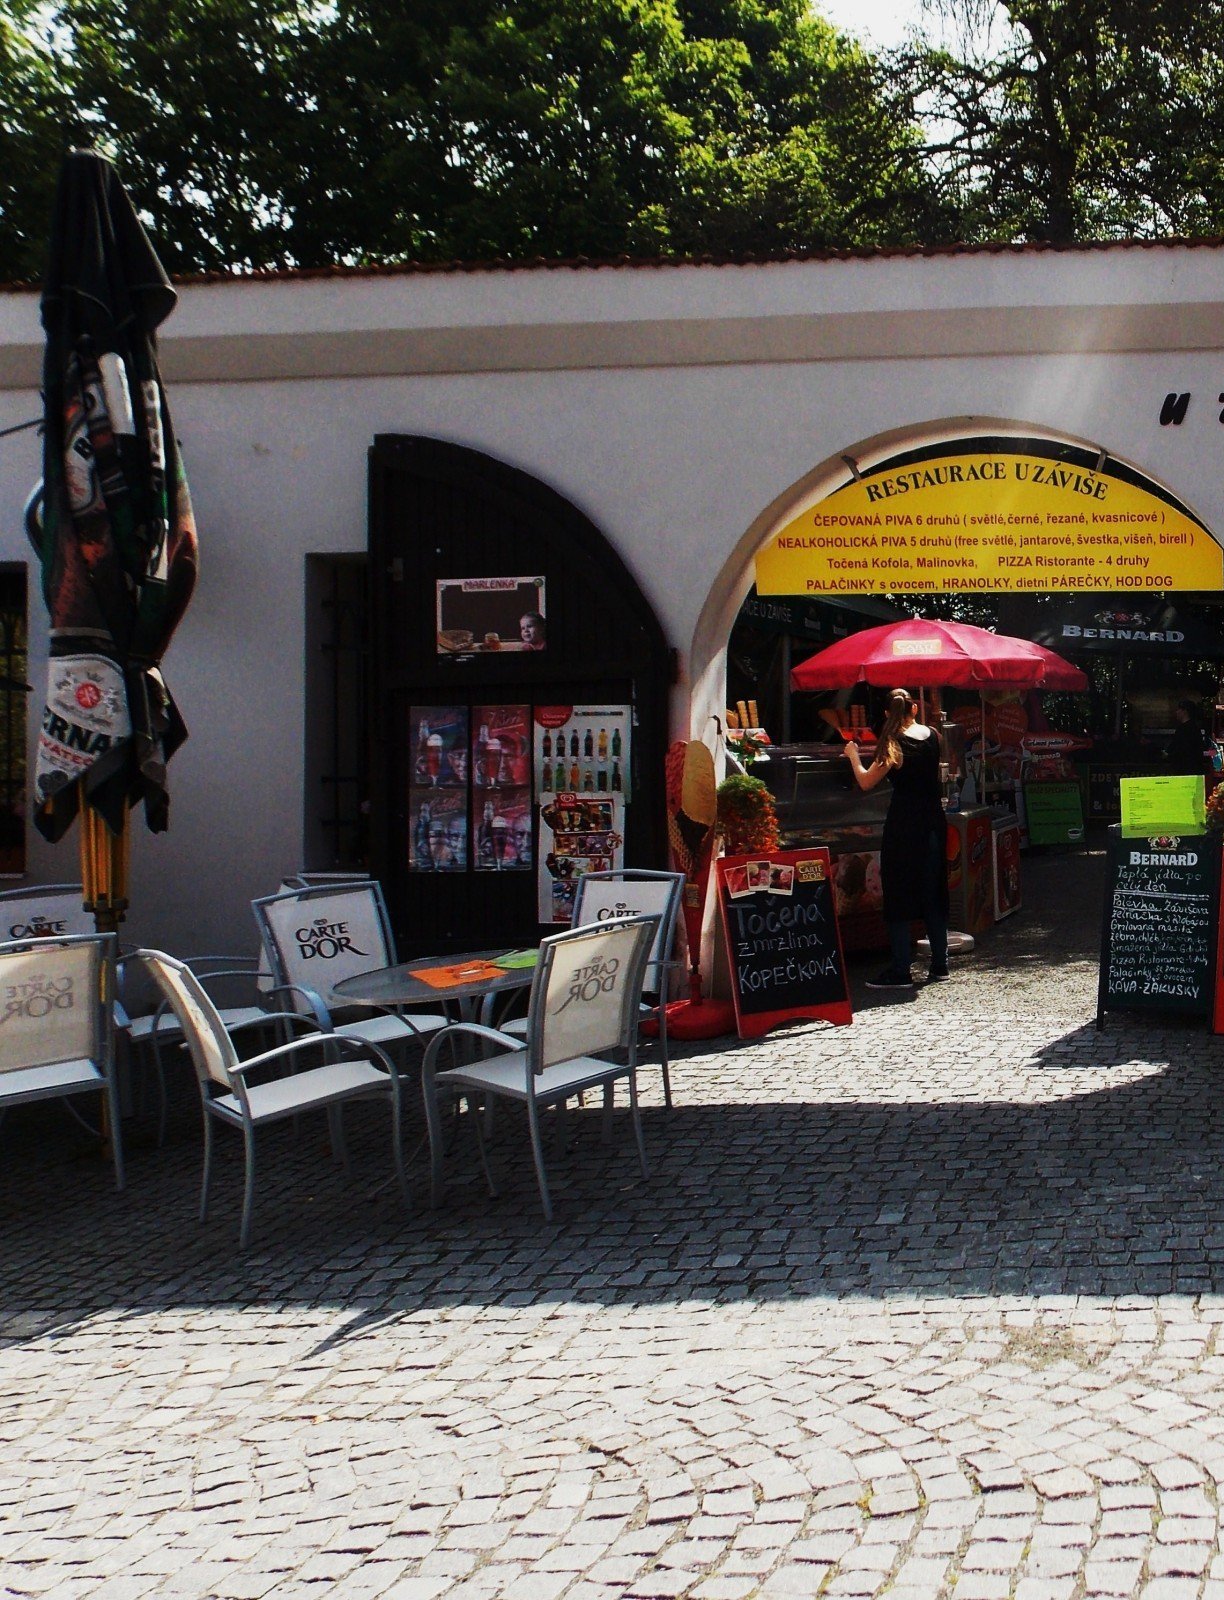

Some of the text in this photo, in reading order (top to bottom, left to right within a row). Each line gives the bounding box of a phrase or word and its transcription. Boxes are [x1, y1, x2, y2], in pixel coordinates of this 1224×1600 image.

[1159, 392, 1191, 426] U
[865, 462, 1109, 502] RESTAURACE U ZÁVIŠE
[813, 512, 882, 527] ČEPOVANÁ
[885, 515, 913, 526] PIVA
[916, 515, 923, 526] 6
[926, 513, 960, 526] druhů
[1046, 512, 1089, 526] řezané,
[1092, 511, 1158, 524] kvasnicové
[778, 534, 878, 549] NEALKOHOLICKÁ
[881, 536, 907, 547] PIVA
[910, 536, 917, 547] 5
[920, 535, 952, 547] druhů
[954, 534, 979, 549] (free
[981, 534, 1017, 548] světlé,
[1018, 534, 1075, 549] jantarové,
[1159, 533, 1187, 545] birell
[826, 555, 1150, 571] Točená Kofola, Malinovka, PIZZA Ristorante 4 druhy
[806, 573, 1173, 591] PALAČINKY s ovocem, HRANOLKY, dietní PÁREČKY, HOD DOG
[1062, 624, 1185, 643] BERNARD
[1129, 851, 1199, 867] BERNARD
[799, 865, 824, 874] CARTE
[1117, 865, 1149, 882] Teplá
[1152, 867, 1184, 883] jídla
[727, 885, 825, 938] Točená
[295, 921, 349, 943] CARTE
[298, 937, 371, 960] D'OR
[738, 929, 823, 956] zmrzlina
[738, 950, 838, 994] KOPEČKOVÁ
